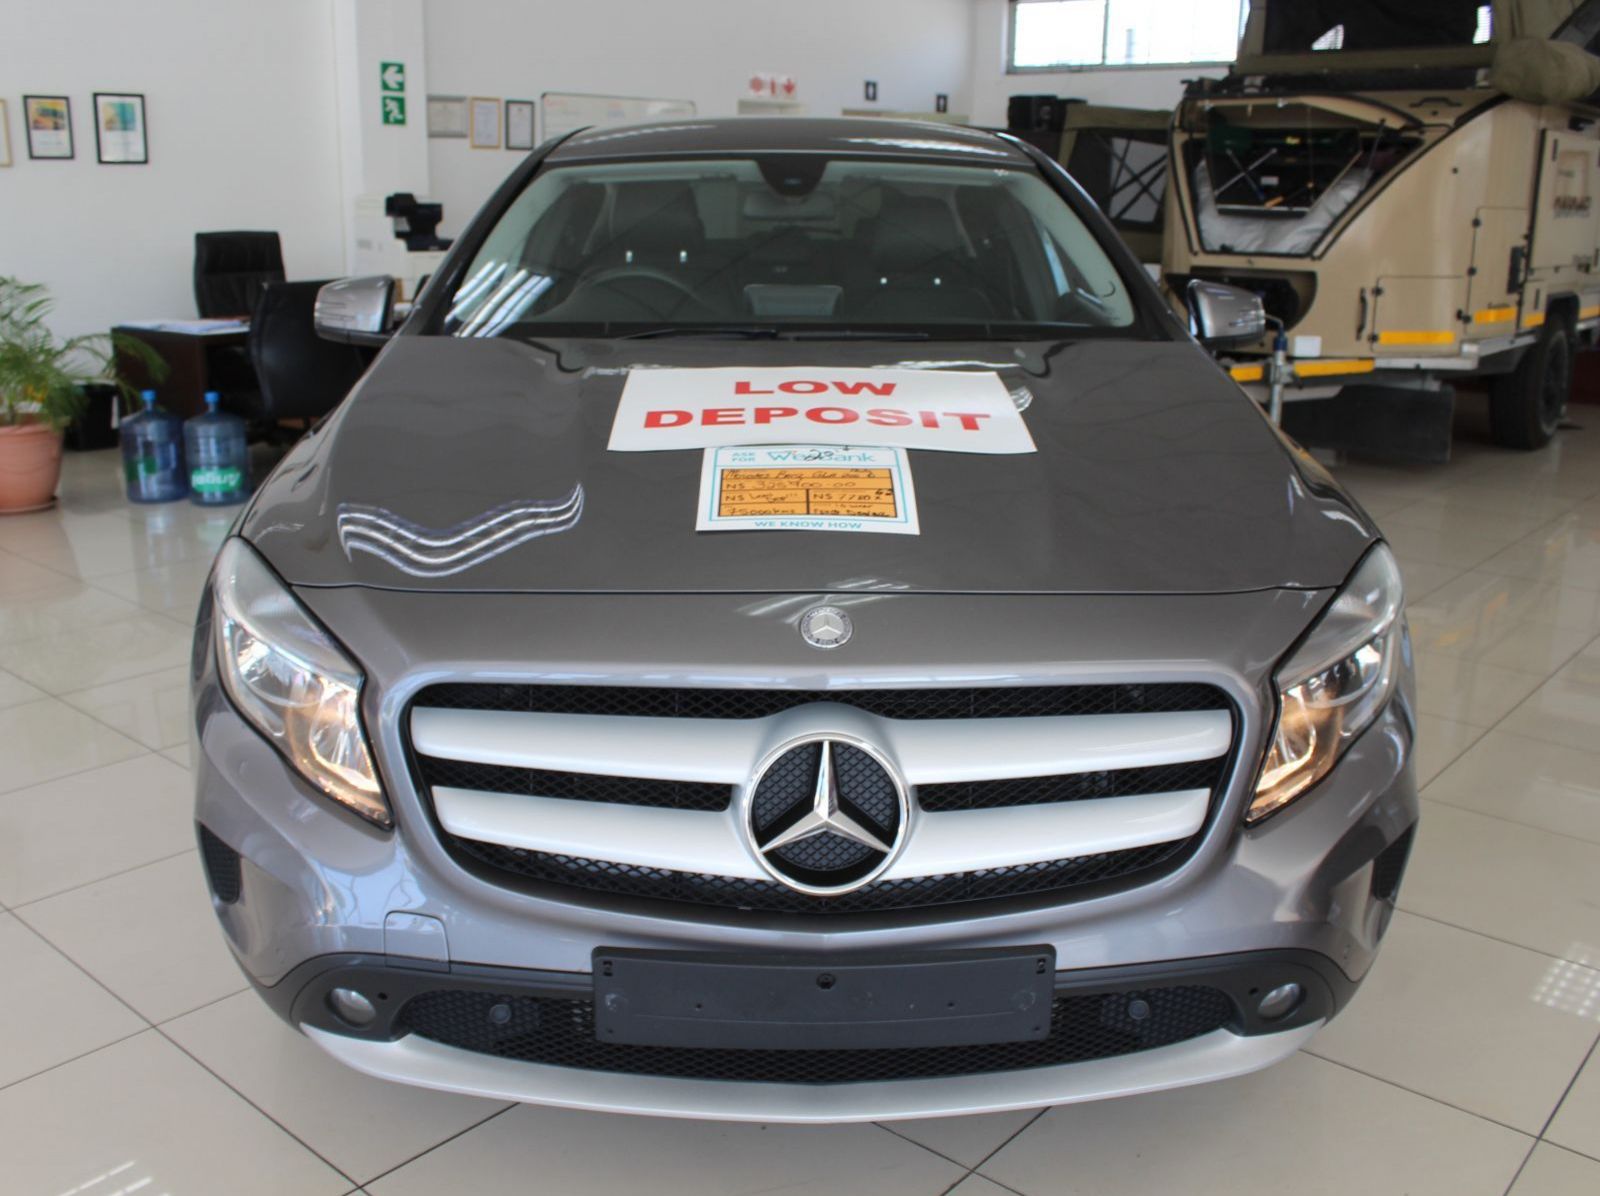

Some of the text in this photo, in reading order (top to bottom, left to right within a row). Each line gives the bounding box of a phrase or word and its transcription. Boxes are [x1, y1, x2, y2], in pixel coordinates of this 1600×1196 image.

[735, 380, 897, 396] LOW
[643, 406, 991, 431] DEPOSIT
[780, 520, 825, 528] KNOW
[828, 521, 863, 529] HOW
